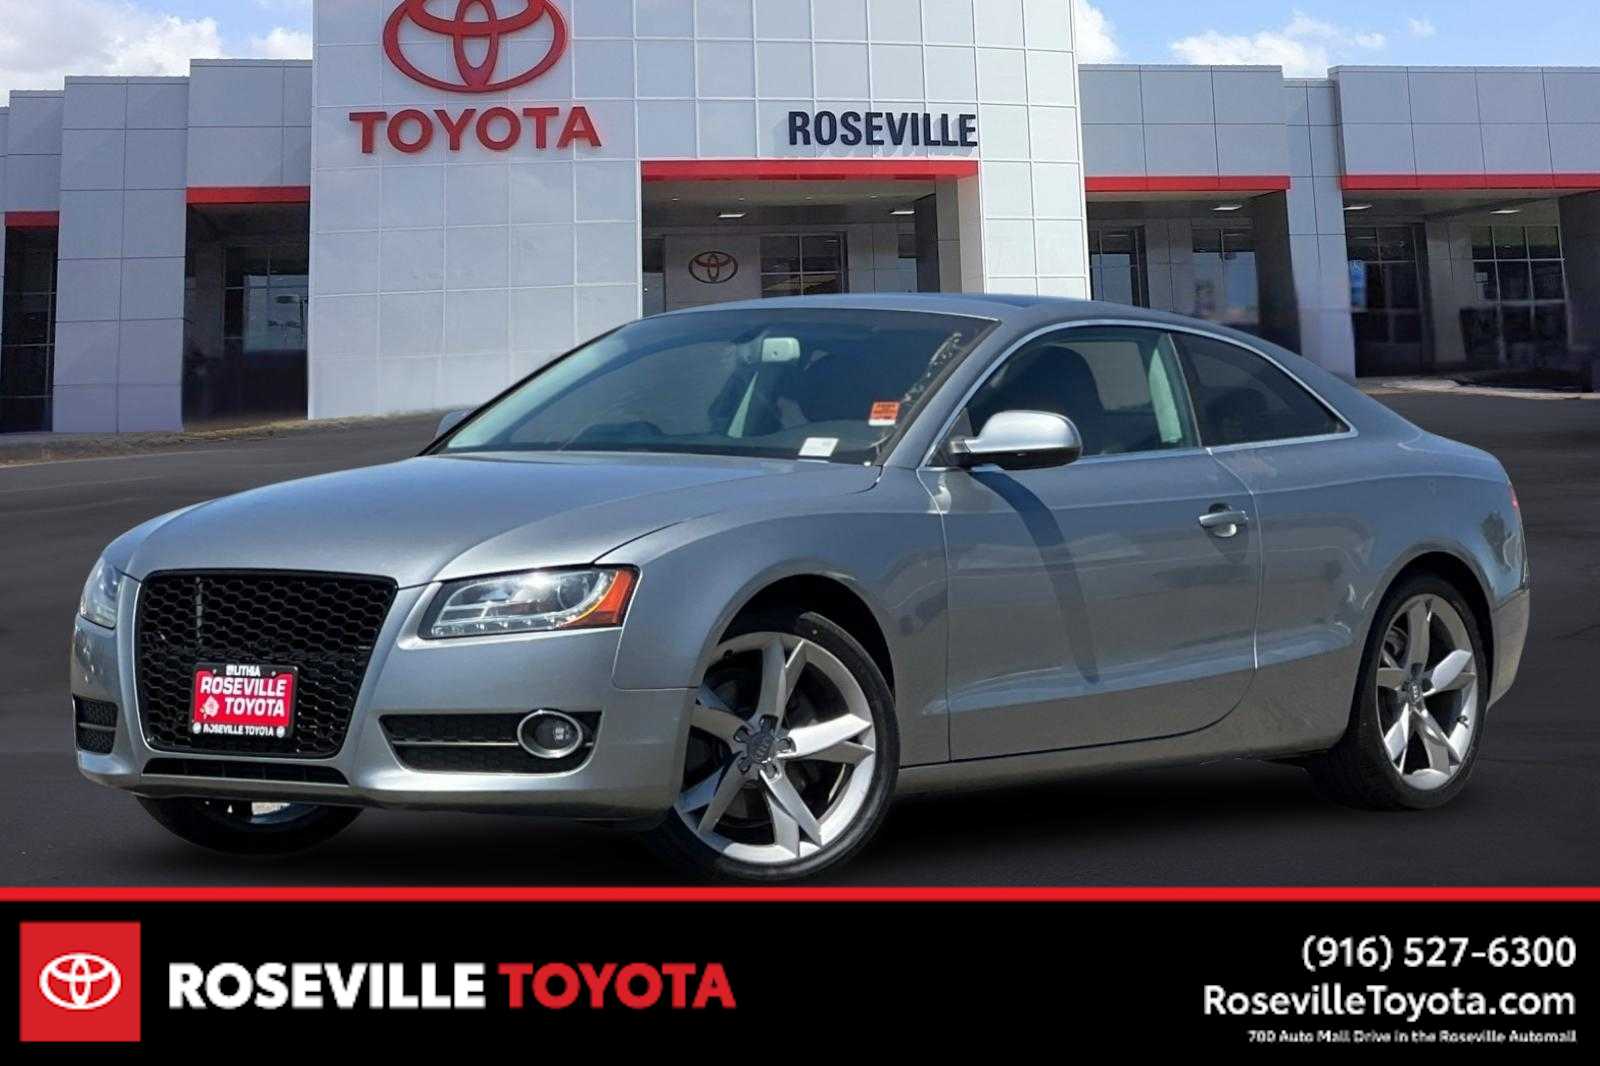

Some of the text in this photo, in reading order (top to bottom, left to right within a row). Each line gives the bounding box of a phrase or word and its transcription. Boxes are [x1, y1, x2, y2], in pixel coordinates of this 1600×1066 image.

[349, 106, 602, 154] TOYOTA
[788, 110, 979, 148] ROSEVILLE
[200, 676, 287, 697] ROSEVILLE
[224, 697, 285, 717] TOYOTA
[203, 723, 274, 736] ROSEVILLE TOYOTA
